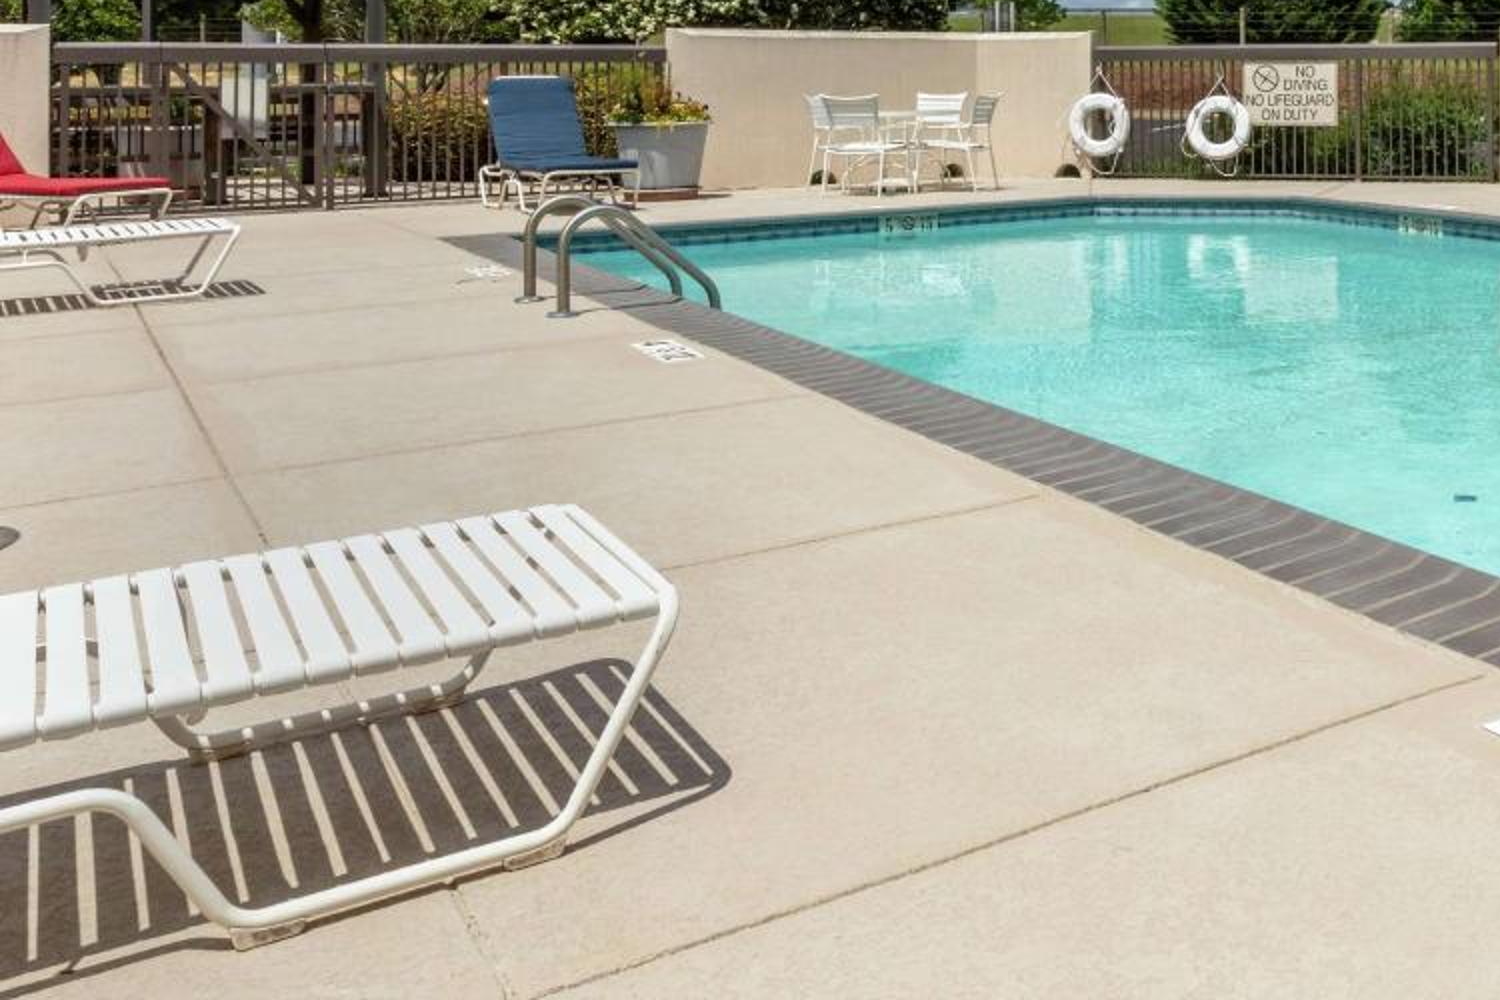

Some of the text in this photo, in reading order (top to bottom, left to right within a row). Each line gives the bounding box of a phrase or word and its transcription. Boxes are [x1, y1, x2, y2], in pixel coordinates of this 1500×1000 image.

[1295, 65, 1316, 79] NO
[1283, 79, 1329, 91] DIVING
[1246, 93, 1265, 107] NO
[1267, 93, 1335, 107] LIFEGUARD
[1261, 108, 1281, 121] ON
[1283, 108, 1319, 121] DUTY
